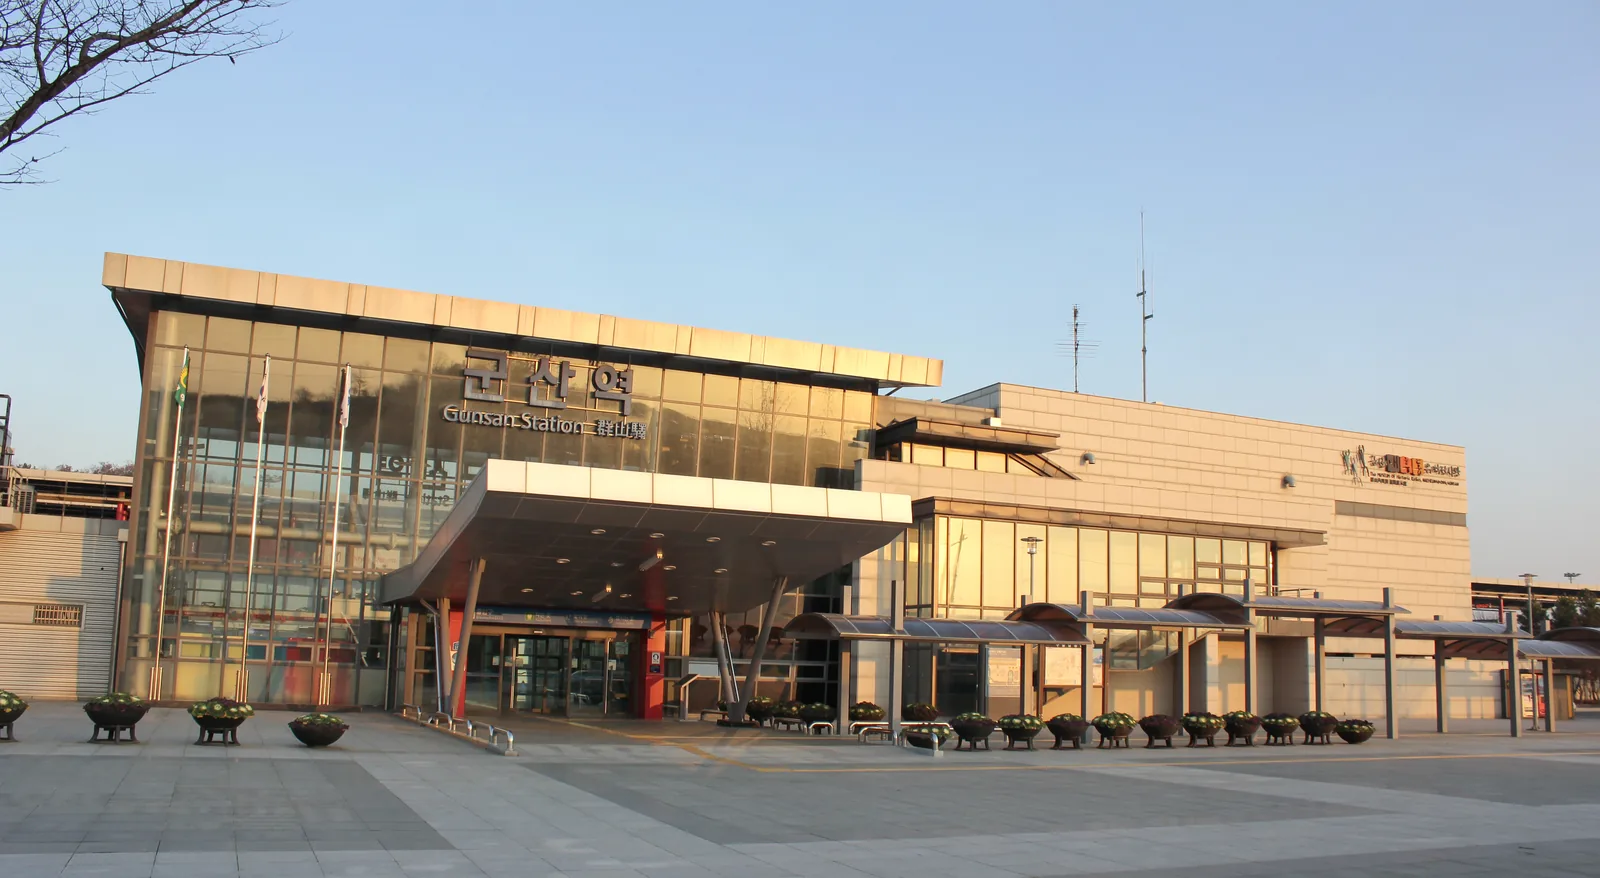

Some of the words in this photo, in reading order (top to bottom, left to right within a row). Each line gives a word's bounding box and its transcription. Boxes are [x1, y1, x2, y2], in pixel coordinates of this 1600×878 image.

[463, 350, 634, 416] 군산역
[443, 404, 516, 430] Gunsan
[521, 412, 584, 434] Station
[597, 419, 647, 440] 群山驛
